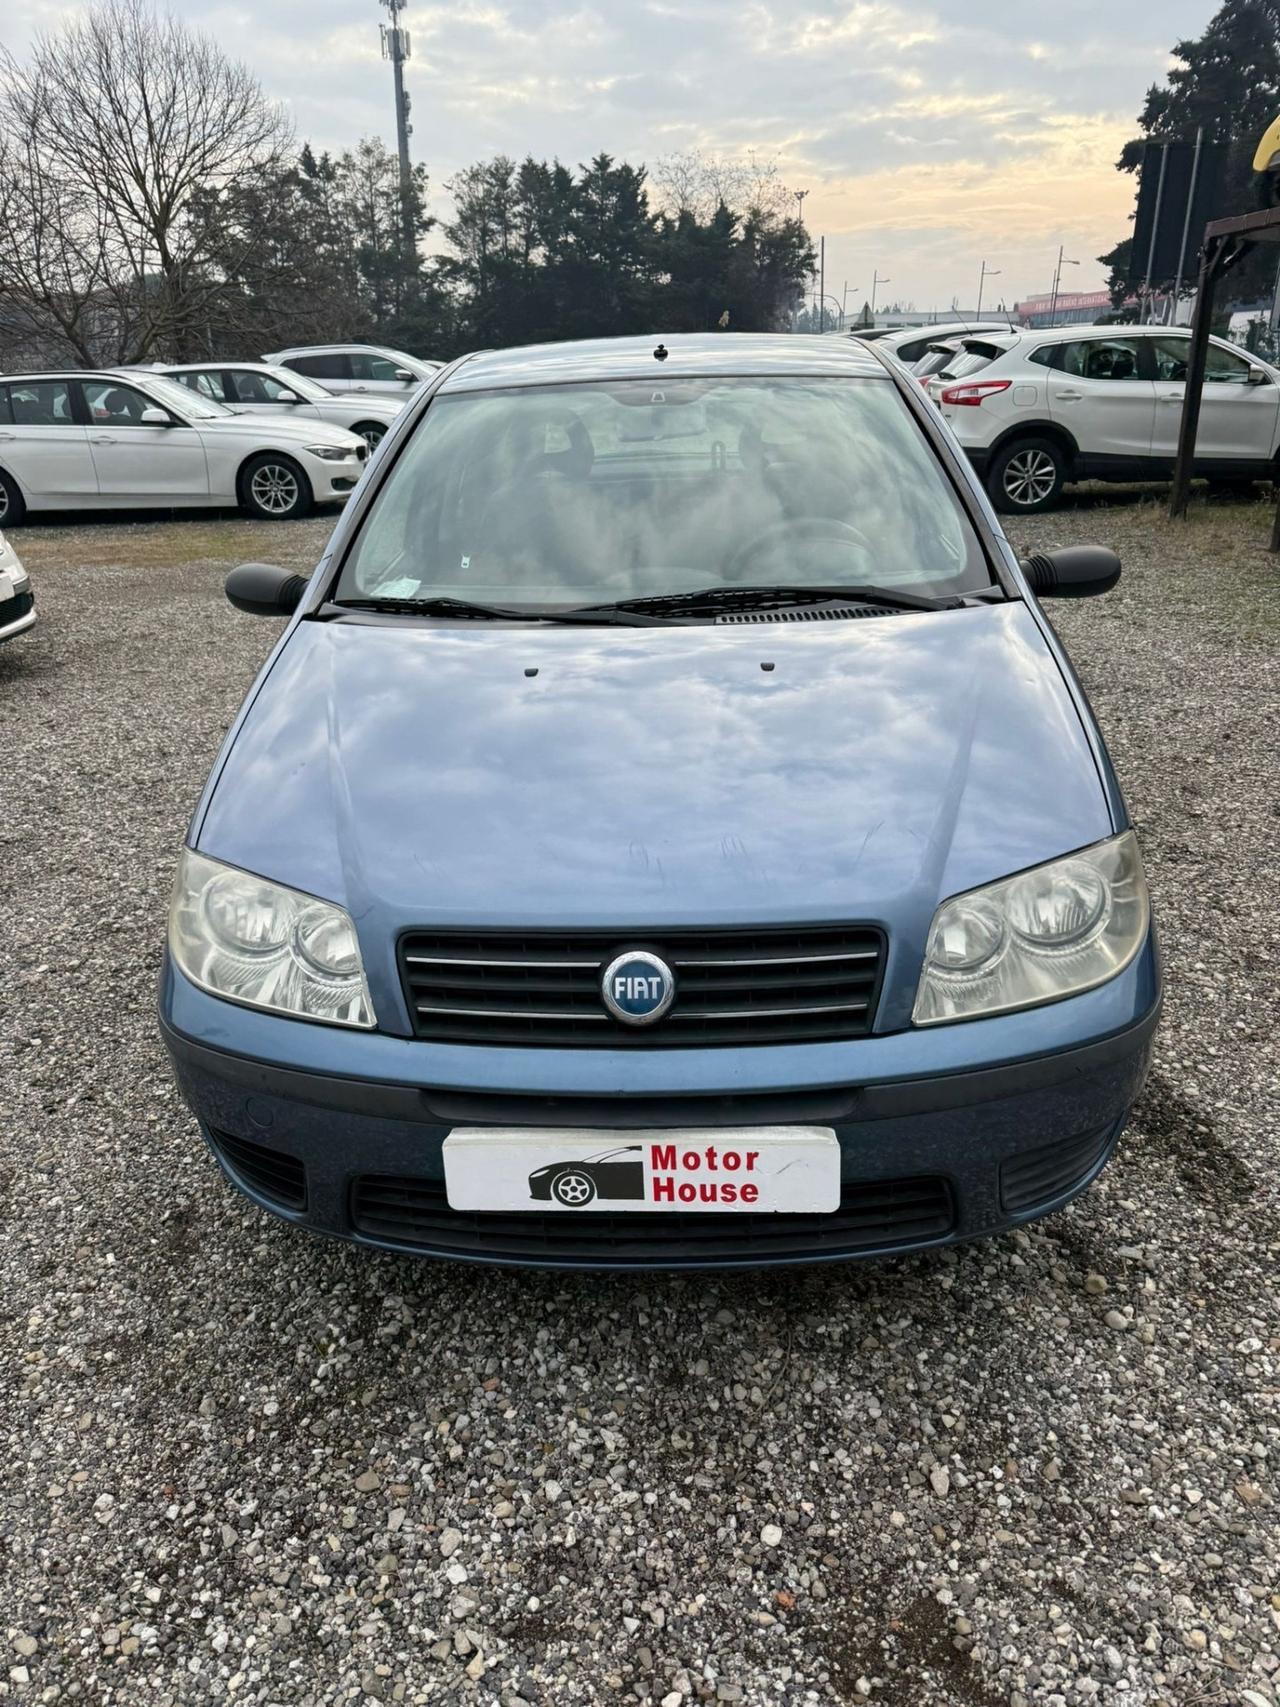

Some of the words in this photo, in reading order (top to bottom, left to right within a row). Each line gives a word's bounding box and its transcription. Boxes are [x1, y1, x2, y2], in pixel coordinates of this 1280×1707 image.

[614, 977, 661, 1000] FIAT
[650, 1145, 760, 1171] Motor
[652, 1177, 759, 1202] House
